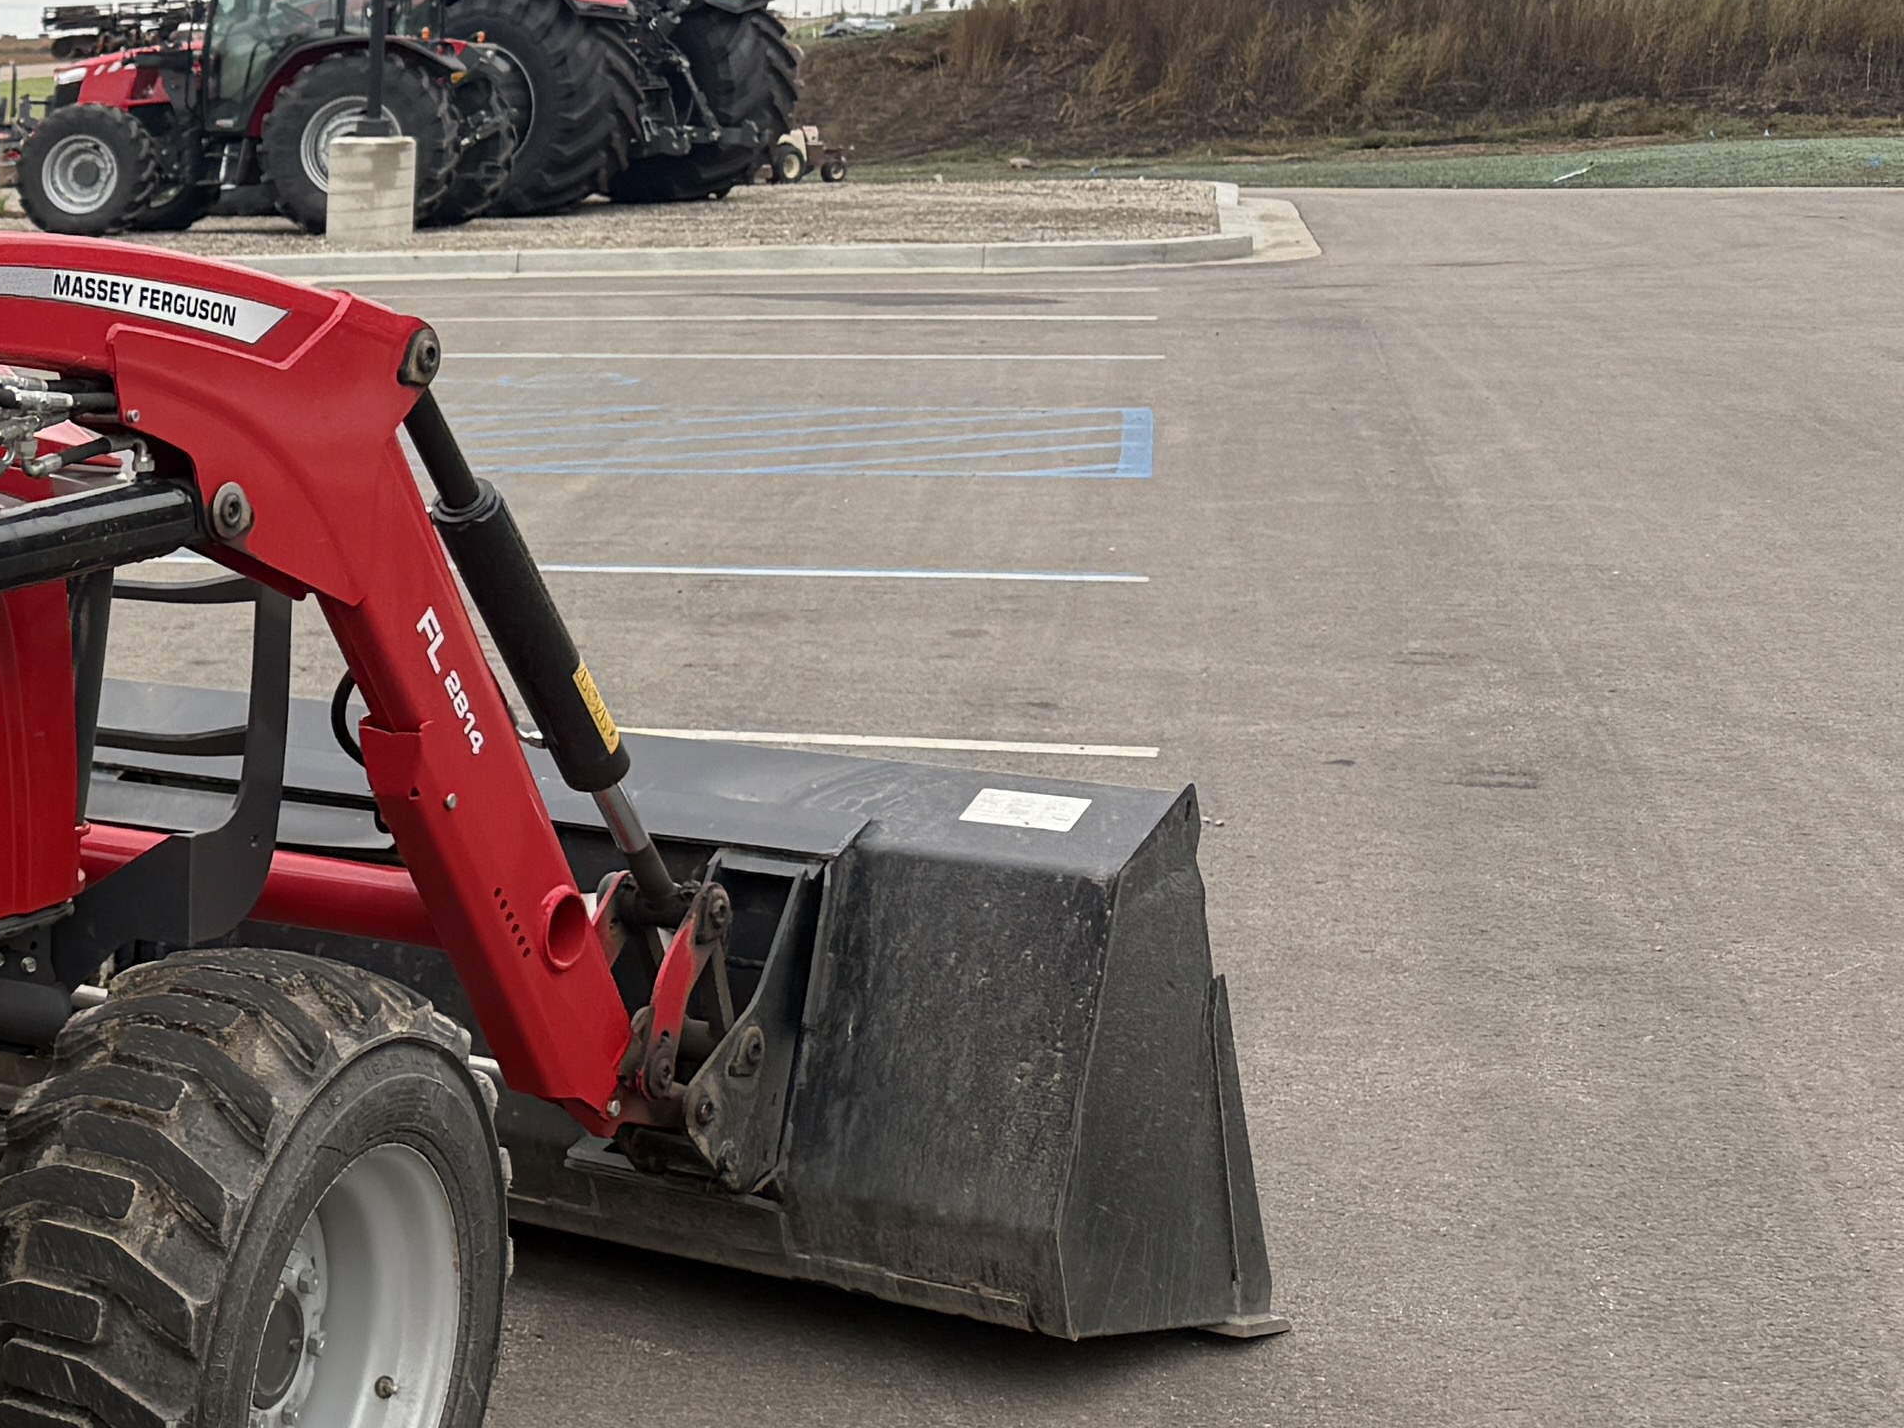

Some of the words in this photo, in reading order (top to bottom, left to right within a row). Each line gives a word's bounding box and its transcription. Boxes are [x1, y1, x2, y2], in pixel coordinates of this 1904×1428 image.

[53, 274, 133, 305] MASSEY
[139, 287, 236, 326] FERGUSON
[416, 606, 444, 675] FL
[444, 670, 485, 756] 2814
